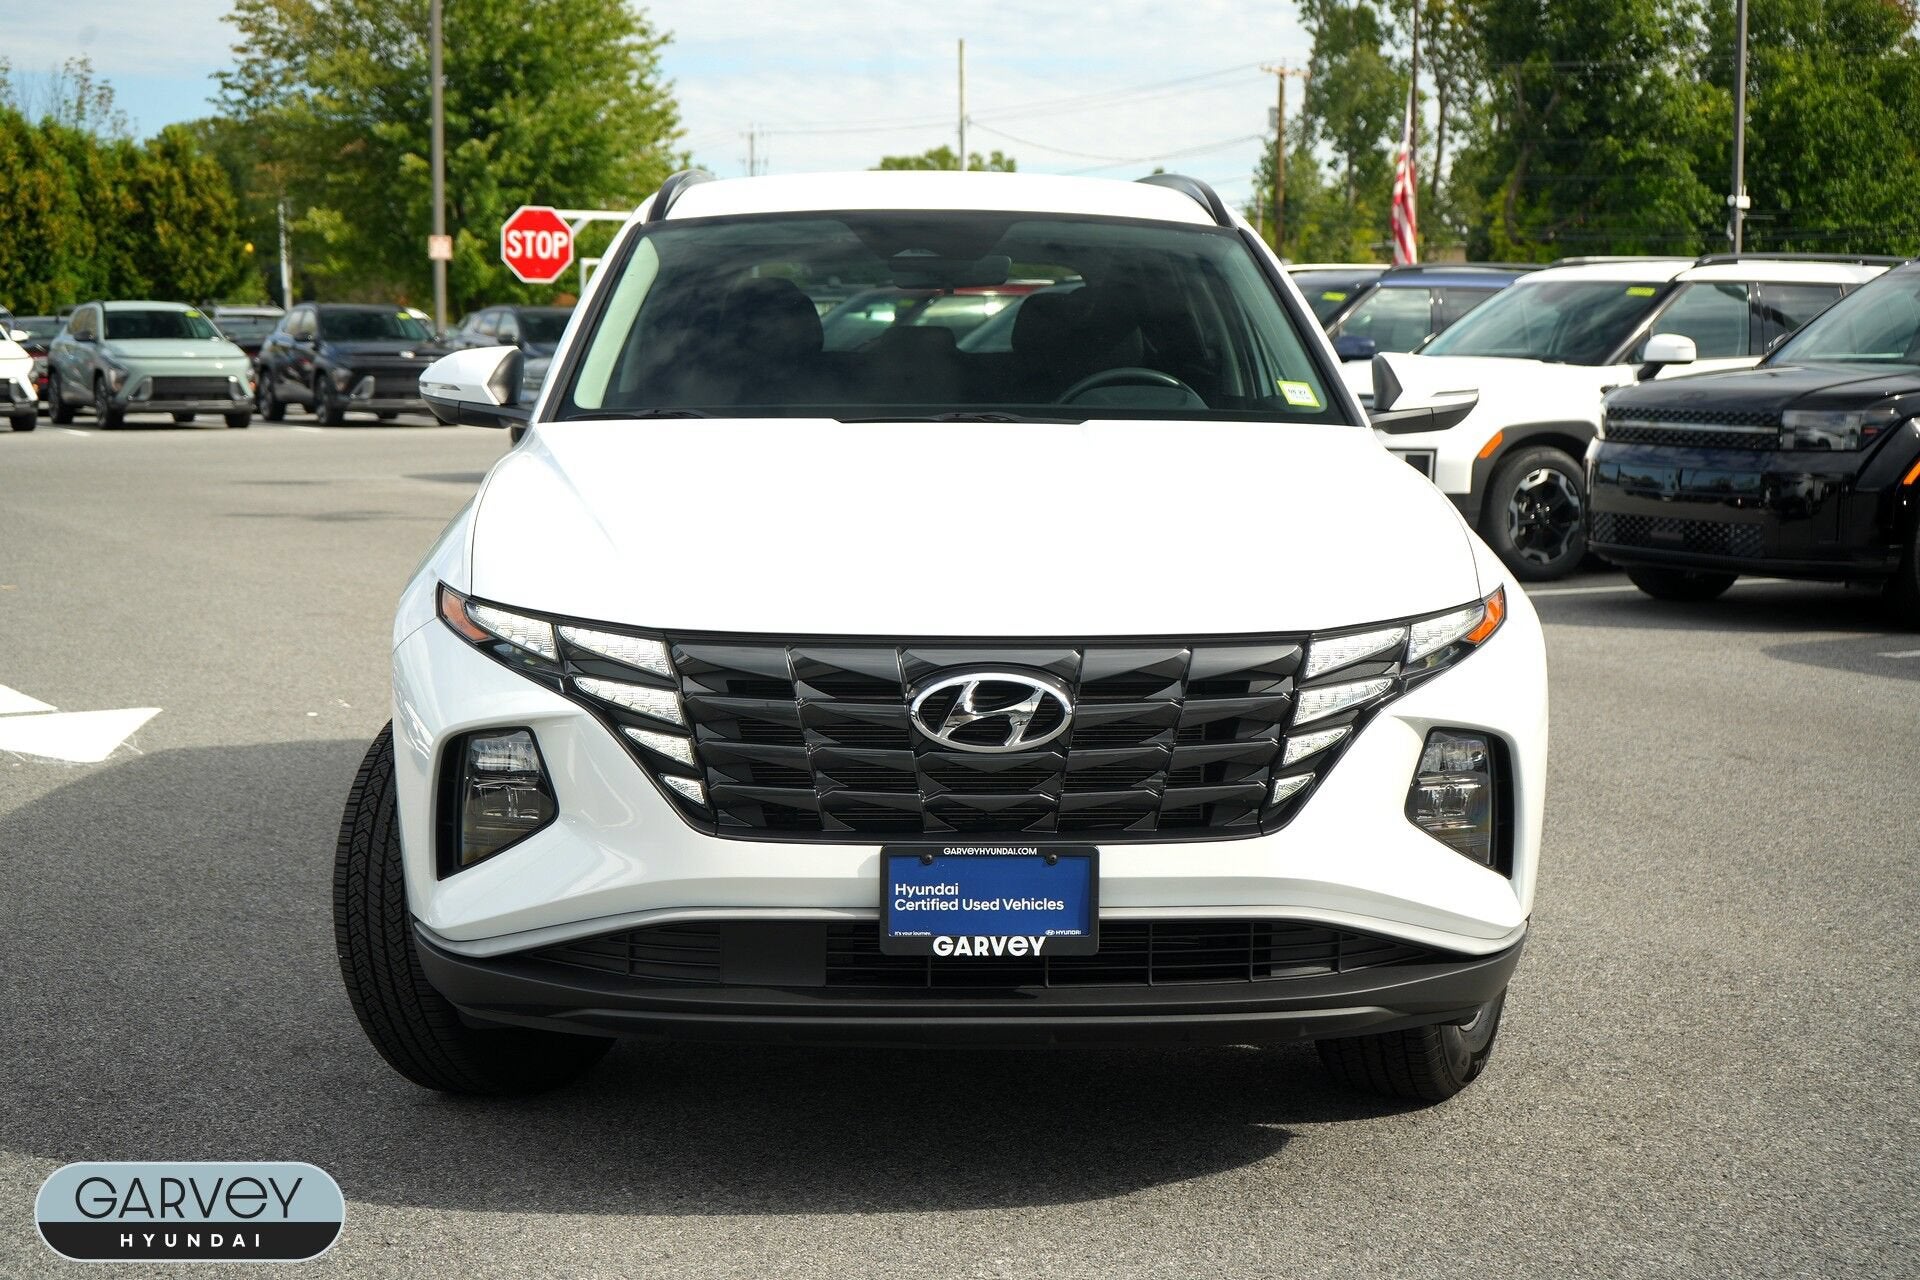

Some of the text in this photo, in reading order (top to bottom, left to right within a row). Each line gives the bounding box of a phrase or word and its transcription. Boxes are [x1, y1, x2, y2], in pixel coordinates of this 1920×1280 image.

[506, 230, 569, 259] STOP
[895, 883, 959, 898] Hyundai
[895, 898, 1065, 911] Certified Used Vehicles
